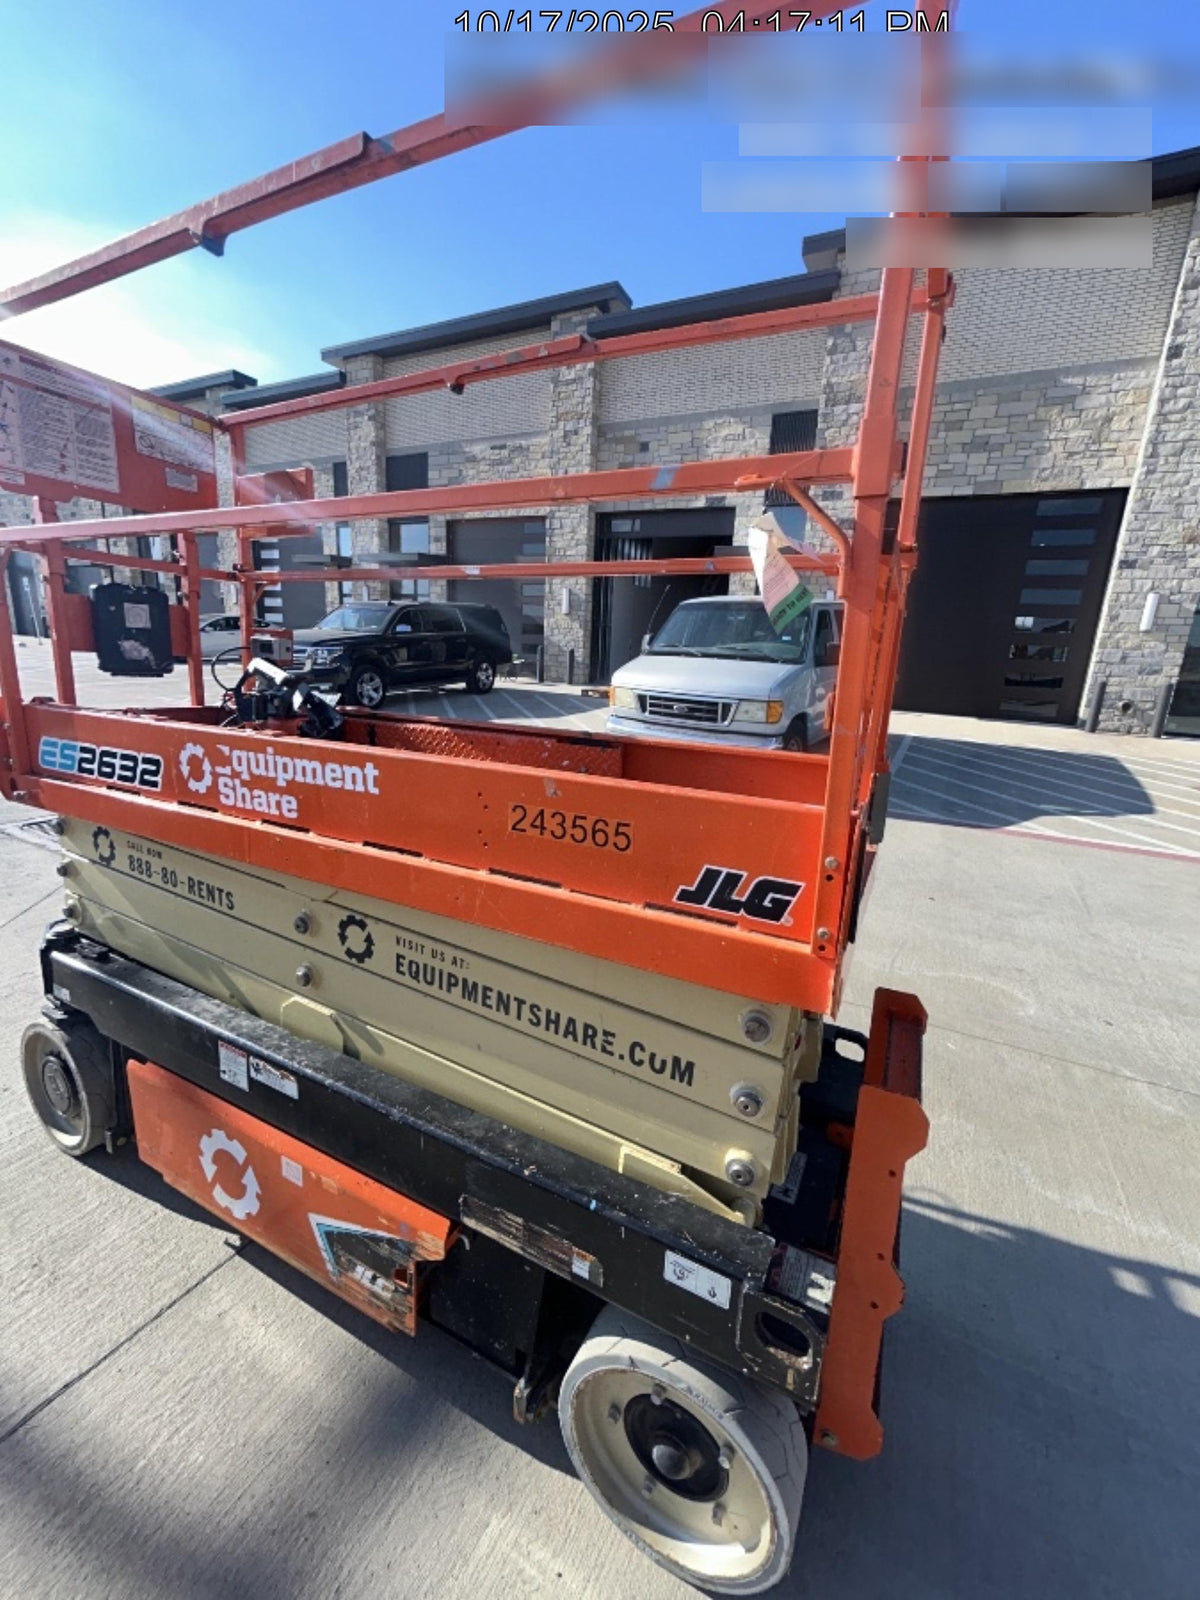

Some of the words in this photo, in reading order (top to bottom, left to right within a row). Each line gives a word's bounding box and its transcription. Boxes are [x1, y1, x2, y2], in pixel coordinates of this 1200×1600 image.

[39, 736, 163, 790] ES2632
[218, 776, 298, 818] Share
[511, 804, 632, 852] 243565
[128, 854, 235, 911] 888-80-RENTS
[673, 864, 806, 925] JLG
[395, 935, 425, 955] VISIT
[431, 948, 446, 962] US
[451, 955, 471, 969] AT:
